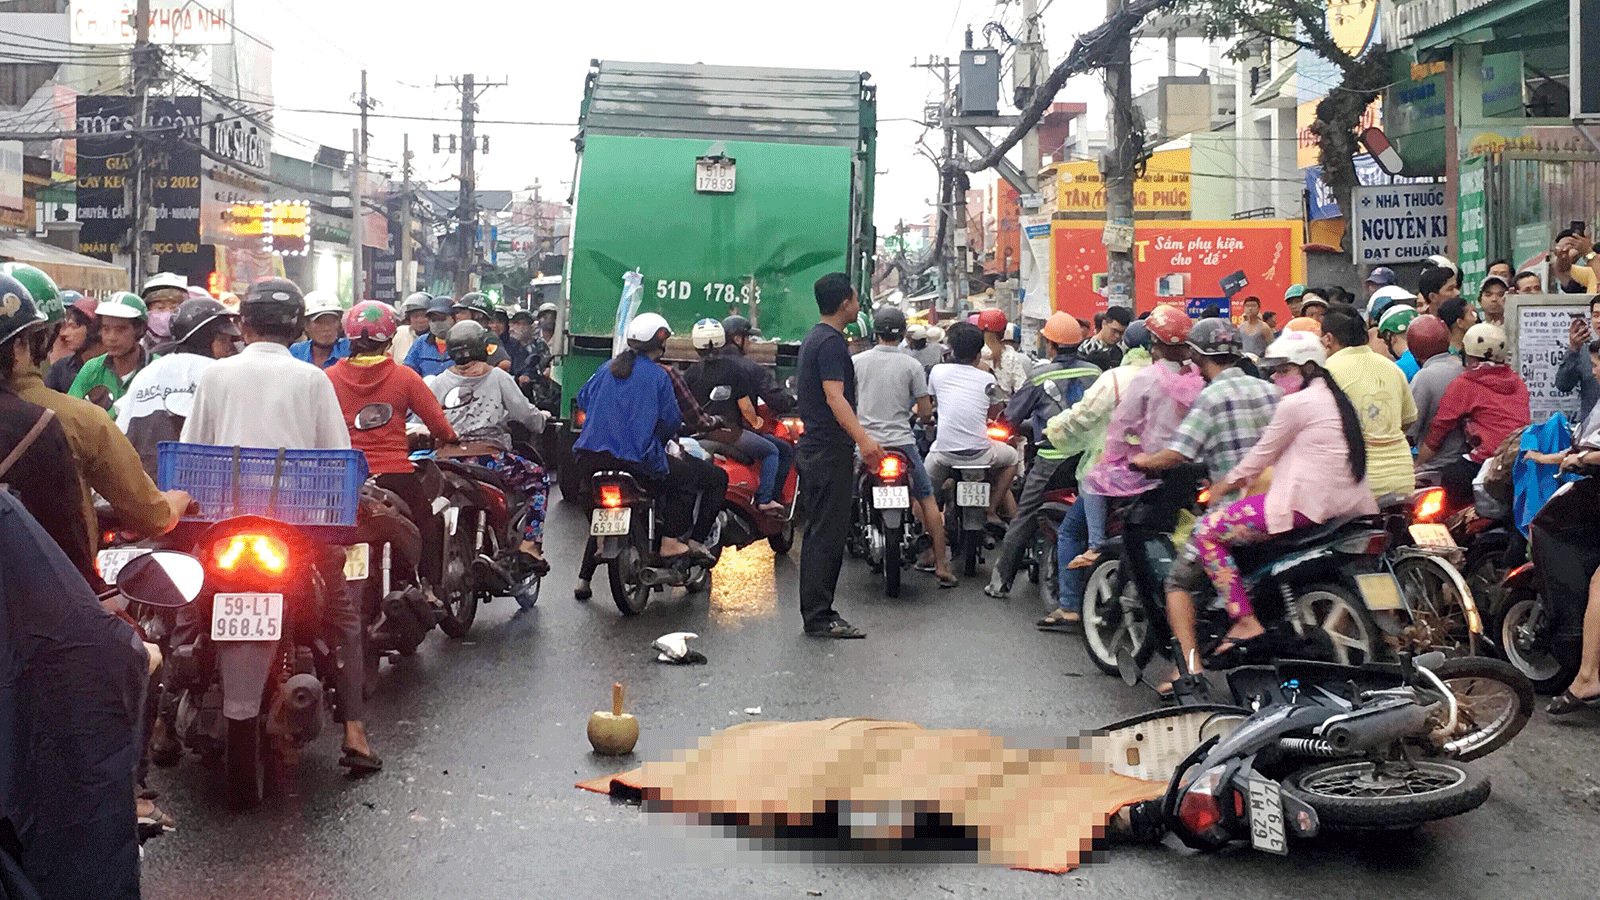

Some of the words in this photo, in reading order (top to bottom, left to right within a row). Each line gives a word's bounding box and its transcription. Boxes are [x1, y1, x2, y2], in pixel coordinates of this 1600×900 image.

[198, 8, 226, 32] NHI
[706, 165, 726, 178] 51D
[170, 176, 199, 189] 2012
[699, 177, 734, 190] 178.93
[1065, 188, 1090, 207] TÂN
[1152, 187, 1187, 207] PHÚC
[1375, 190, 1400, 208] NHÀ
[1403, 187, 1444, 208] THUỐC
[1361, 211, 1427, 241] NGUYÊN
[1431, 215, 1448, 238] KI
[175, 241, 199, 254] VIÊN
[1154, 236, 1185, 251] Sắm
[1187, 236, 1213, 255] phụ
[1216, 236, 1245, 254] kiện
[1364, 247, 1391, 260] ĐẠT
[1395, 240, 1440, 258] CHUẨN
[1170, 253, 1192, 266] cho
[1198, 250, 1228, 266] "dế"
[656, 279, 692, 300] 51D
[703, 282, 762, 305] 178.93
[224, 597, 270, 616] 59-L1
[216, 618, 277, 636] 968.45
[1250, 790, 1268, 839] 62-M1
